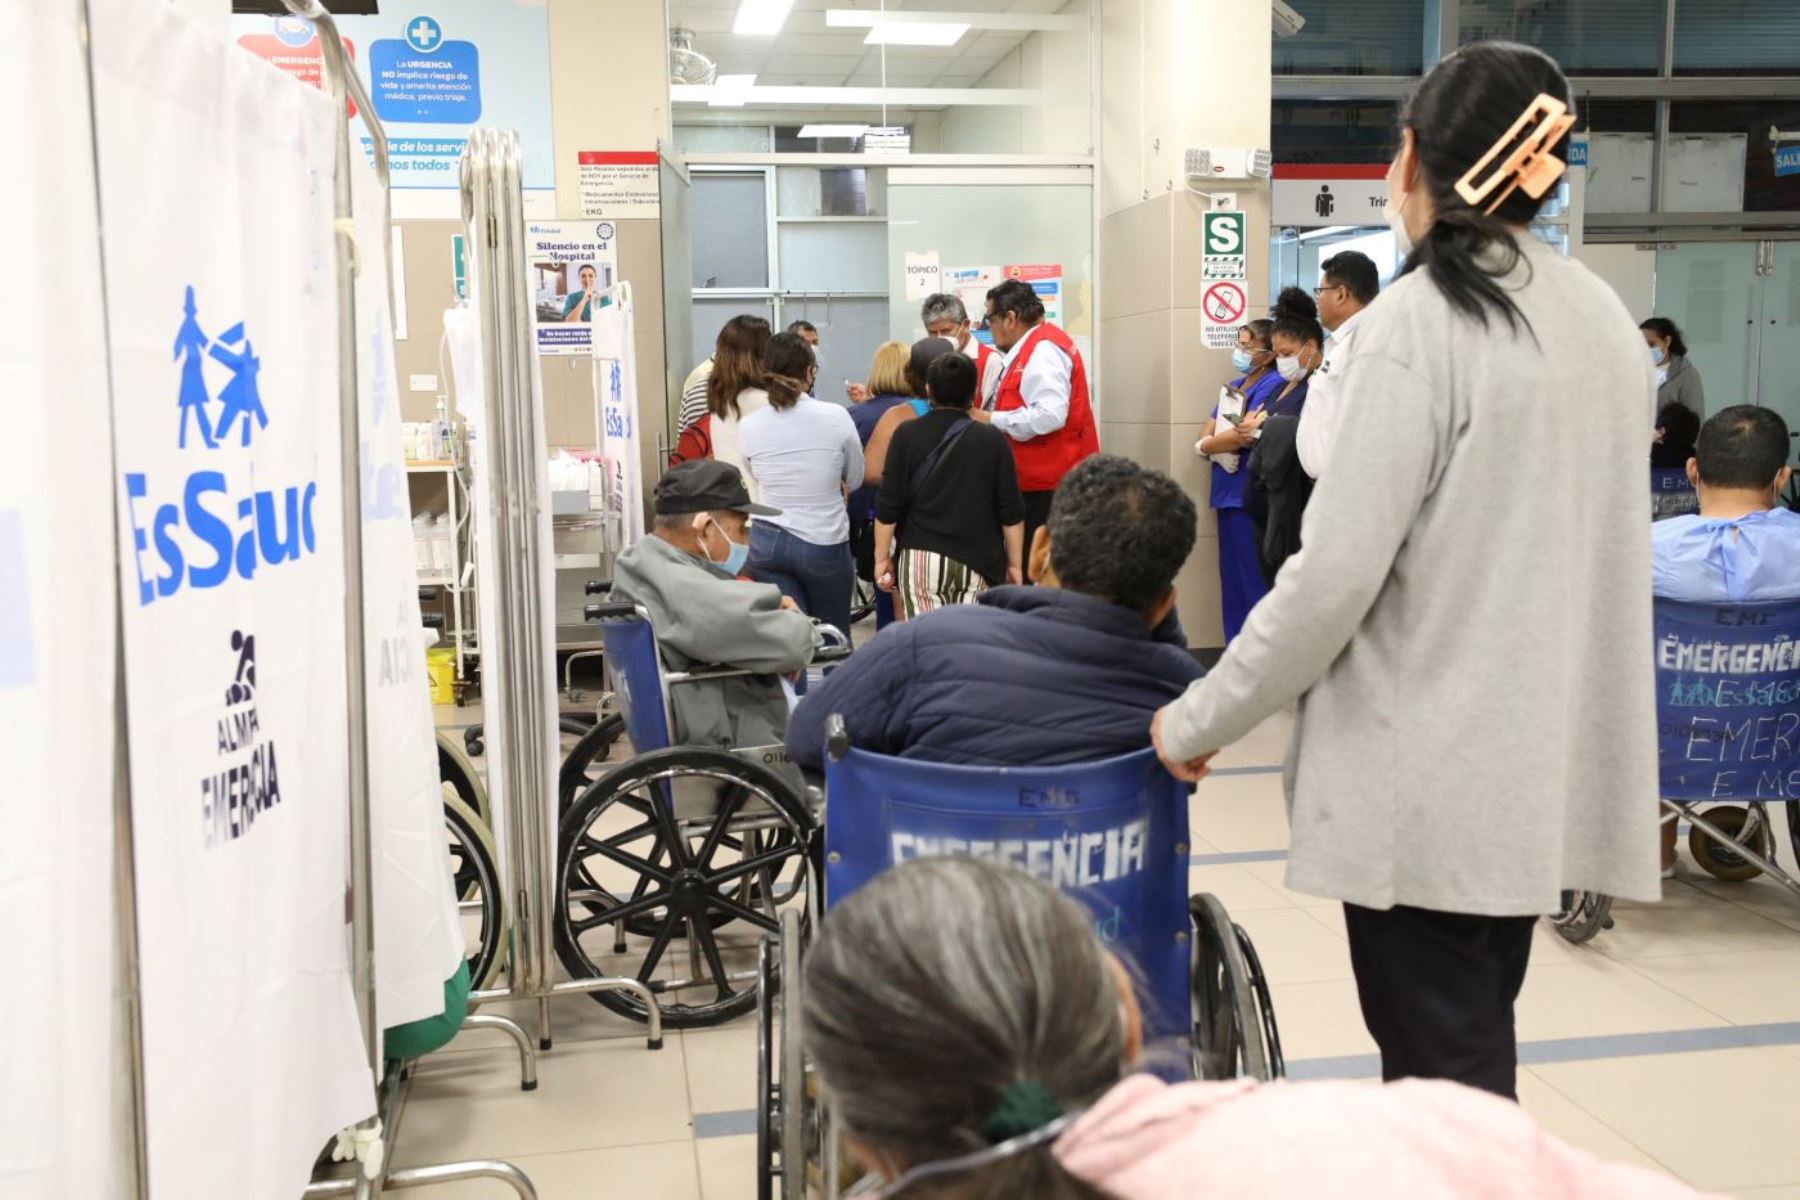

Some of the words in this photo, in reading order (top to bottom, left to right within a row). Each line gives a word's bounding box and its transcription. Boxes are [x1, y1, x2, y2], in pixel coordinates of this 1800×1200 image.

[407, 61, 453, 69] URGENCIA
[381, 71, 395, 79] NO
[397, 71, 428, 81] implica
[430, 71, 455, 82] riesgo
[456, 71, 468, 80] de
[380, 81, 398, 90] vida
[406, 81, 437, 90] amerita
[438, 82, 472, 91] atención
[418, 93, 443, 102] previo
[400, 141, 415, 152] de
[417, 141, 434, 152] los
[435, 141, 466, 152] servi
[412, 159, 450, 170] todos
[1209, 216, 1239, 253] S
[536, 242, 580, 250] Silencio
[597, 242, 608, 250] el
[549, 252, 595, 261] Hospital
[907, 264, 938, 275] TÓPICO
[919, 278, 926, 286] 2
